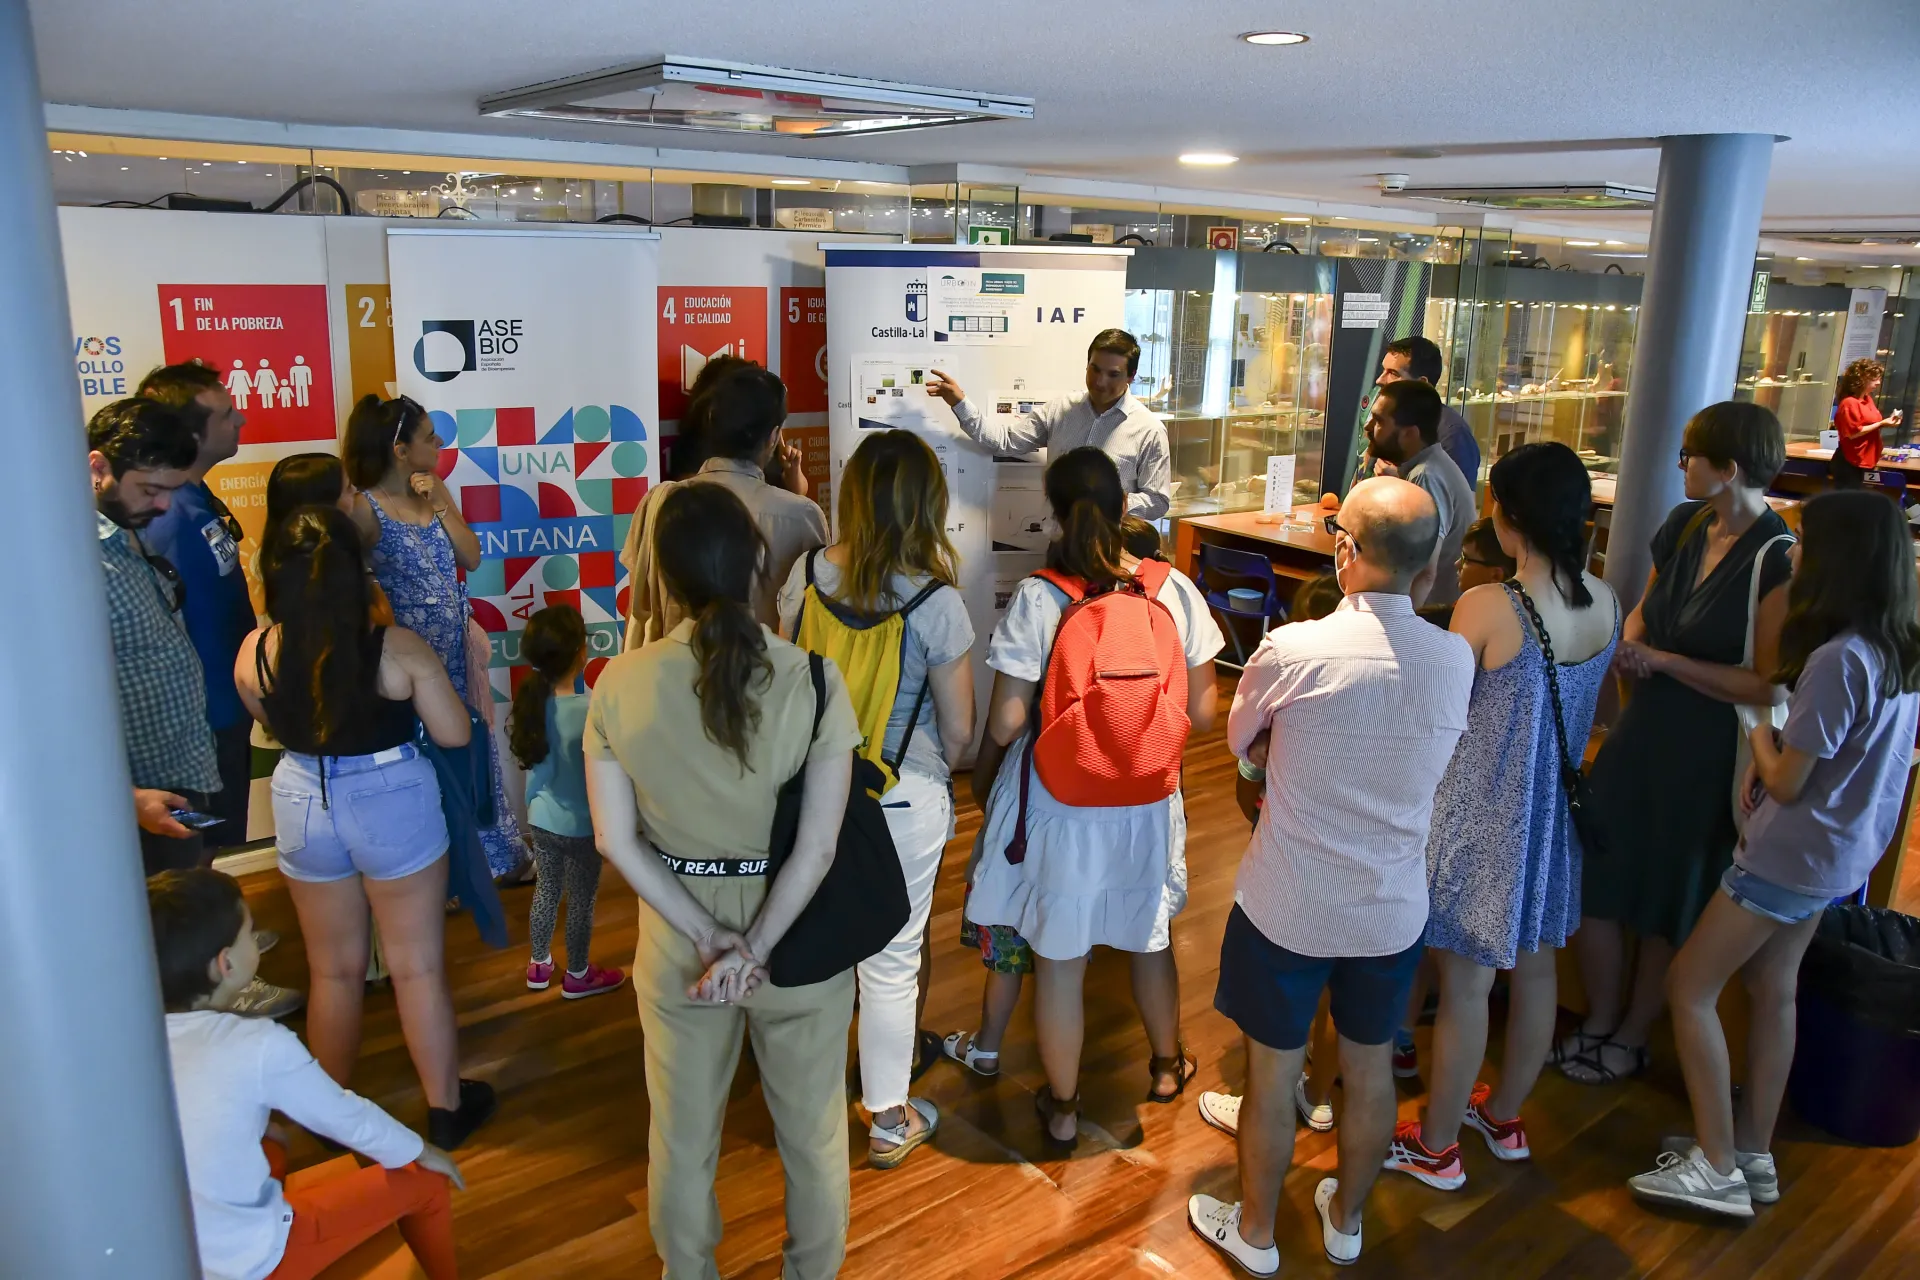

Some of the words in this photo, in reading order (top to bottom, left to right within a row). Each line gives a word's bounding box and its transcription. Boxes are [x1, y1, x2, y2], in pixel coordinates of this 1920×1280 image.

[169, 297, 185, 331] 1
[194, 297, 214, 311] FIN
[358, 296, 376, 328] 2
[663, 297, 677, 325] 4
[684, 294, 732, 308] EDUCACIÓN
[684, 312, 695, 324] DE
[697, 312, 731, 324] CALIDAD
[788, 297, 800, 324] 5
[807, 312, 817, 323] DE
[196, 317, 213, 331] DE
[214, 317, 230, 331] LA
[231, 316, 284, 330] POBREZA
[478, 319, 523, 337] ASE
[480, 338, 519, 355] BIO
[502, 451, 571, 475] UNA
[220, 473, 267, 491] ENERGÍA
[232, 495, 248, 508] NO
[511, 584, 534, 620] AL
[684, 861, 727, 874] REAL
